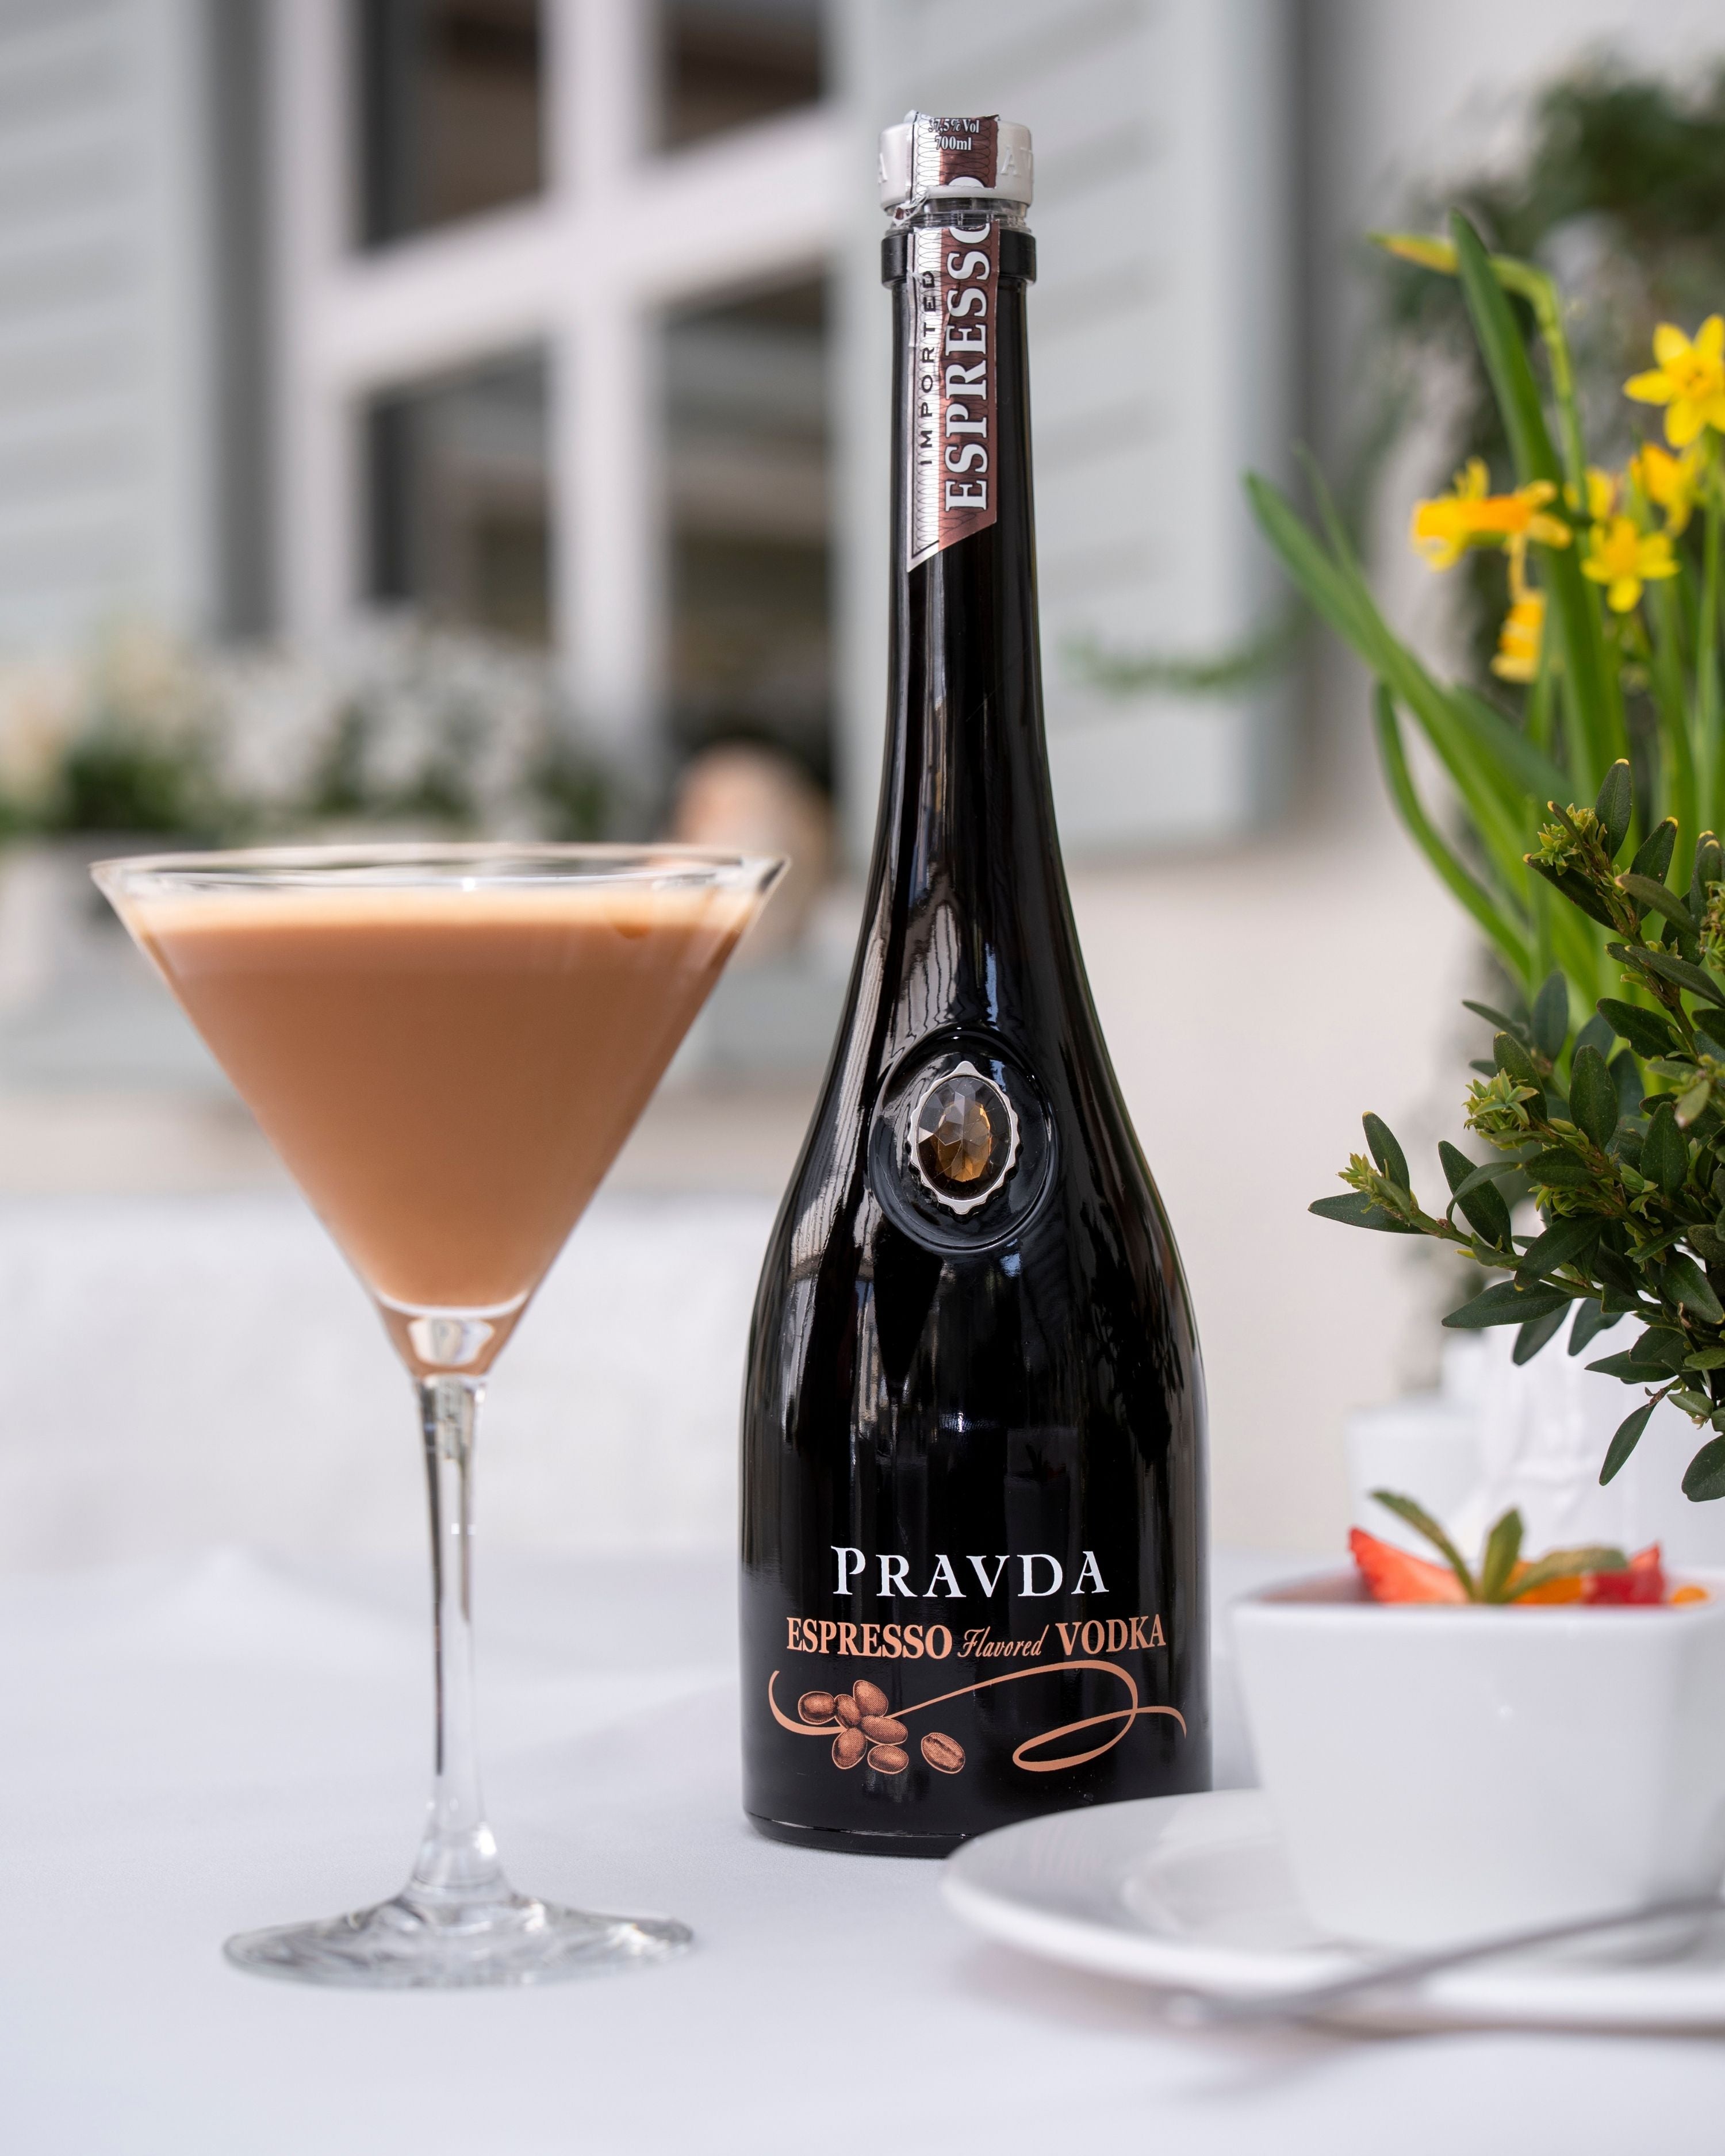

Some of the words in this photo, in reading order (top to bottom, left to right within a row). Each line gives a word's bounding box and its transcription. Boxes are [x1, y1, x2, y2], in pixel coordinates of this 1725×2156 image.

[935, 135, 973, 151] 700ml
[963, 118, 980, 133] Vol
[920, 271, 934, 466] IMPORTED
[831, 1545, 1109, 1598] PRAVDA
[786, 1617, 952, 1660] ESPRESSO
[957, 1624, 1049, 1658] Flavored
[1055, 1614, 1166, 1656] VODKA
